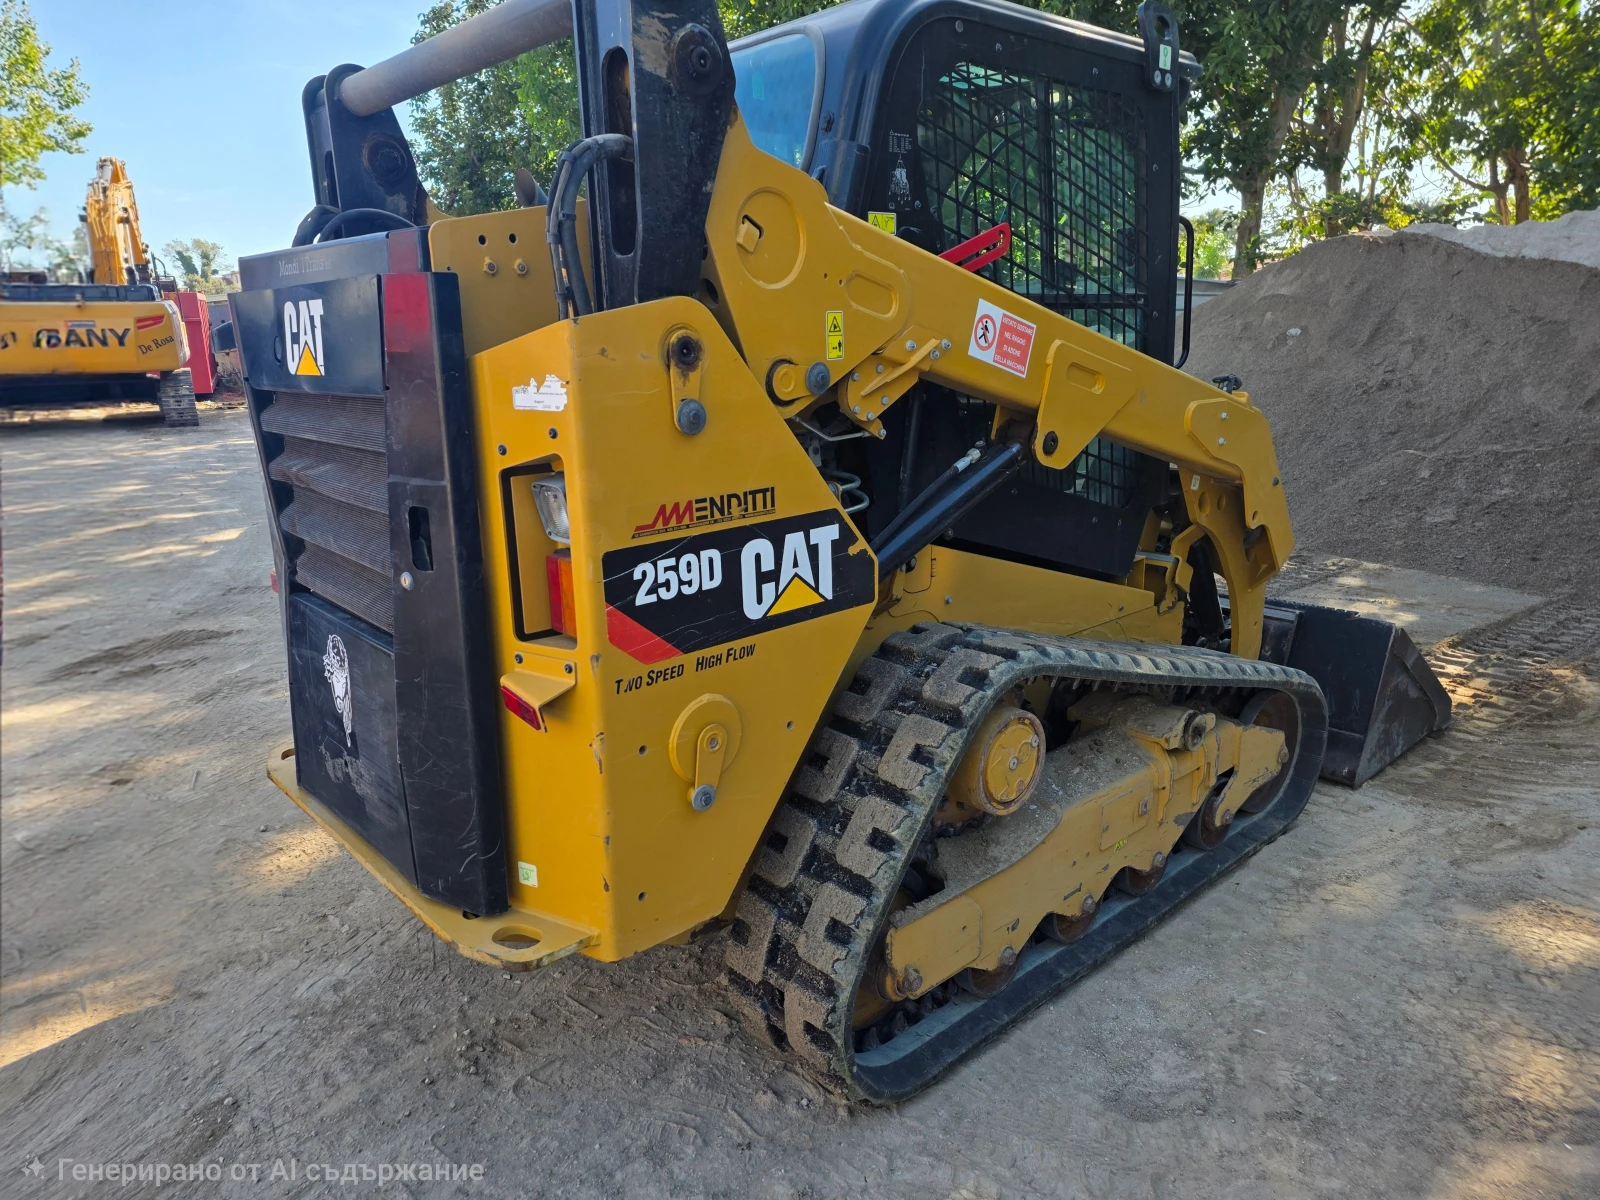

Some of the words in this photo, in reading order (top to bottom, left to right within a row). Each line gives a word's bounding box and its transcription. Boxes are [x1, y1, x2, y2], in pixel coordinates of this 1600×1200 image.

[138, 343, 154, 355] De
[152, 334, 175, 348] Rosa
[284, 299, 325, 376] CAT
[634, 486, 775, 532] MENDITTI
[632, 548, 723, 606] 259D
[741, 523, 840, 620] CAT
